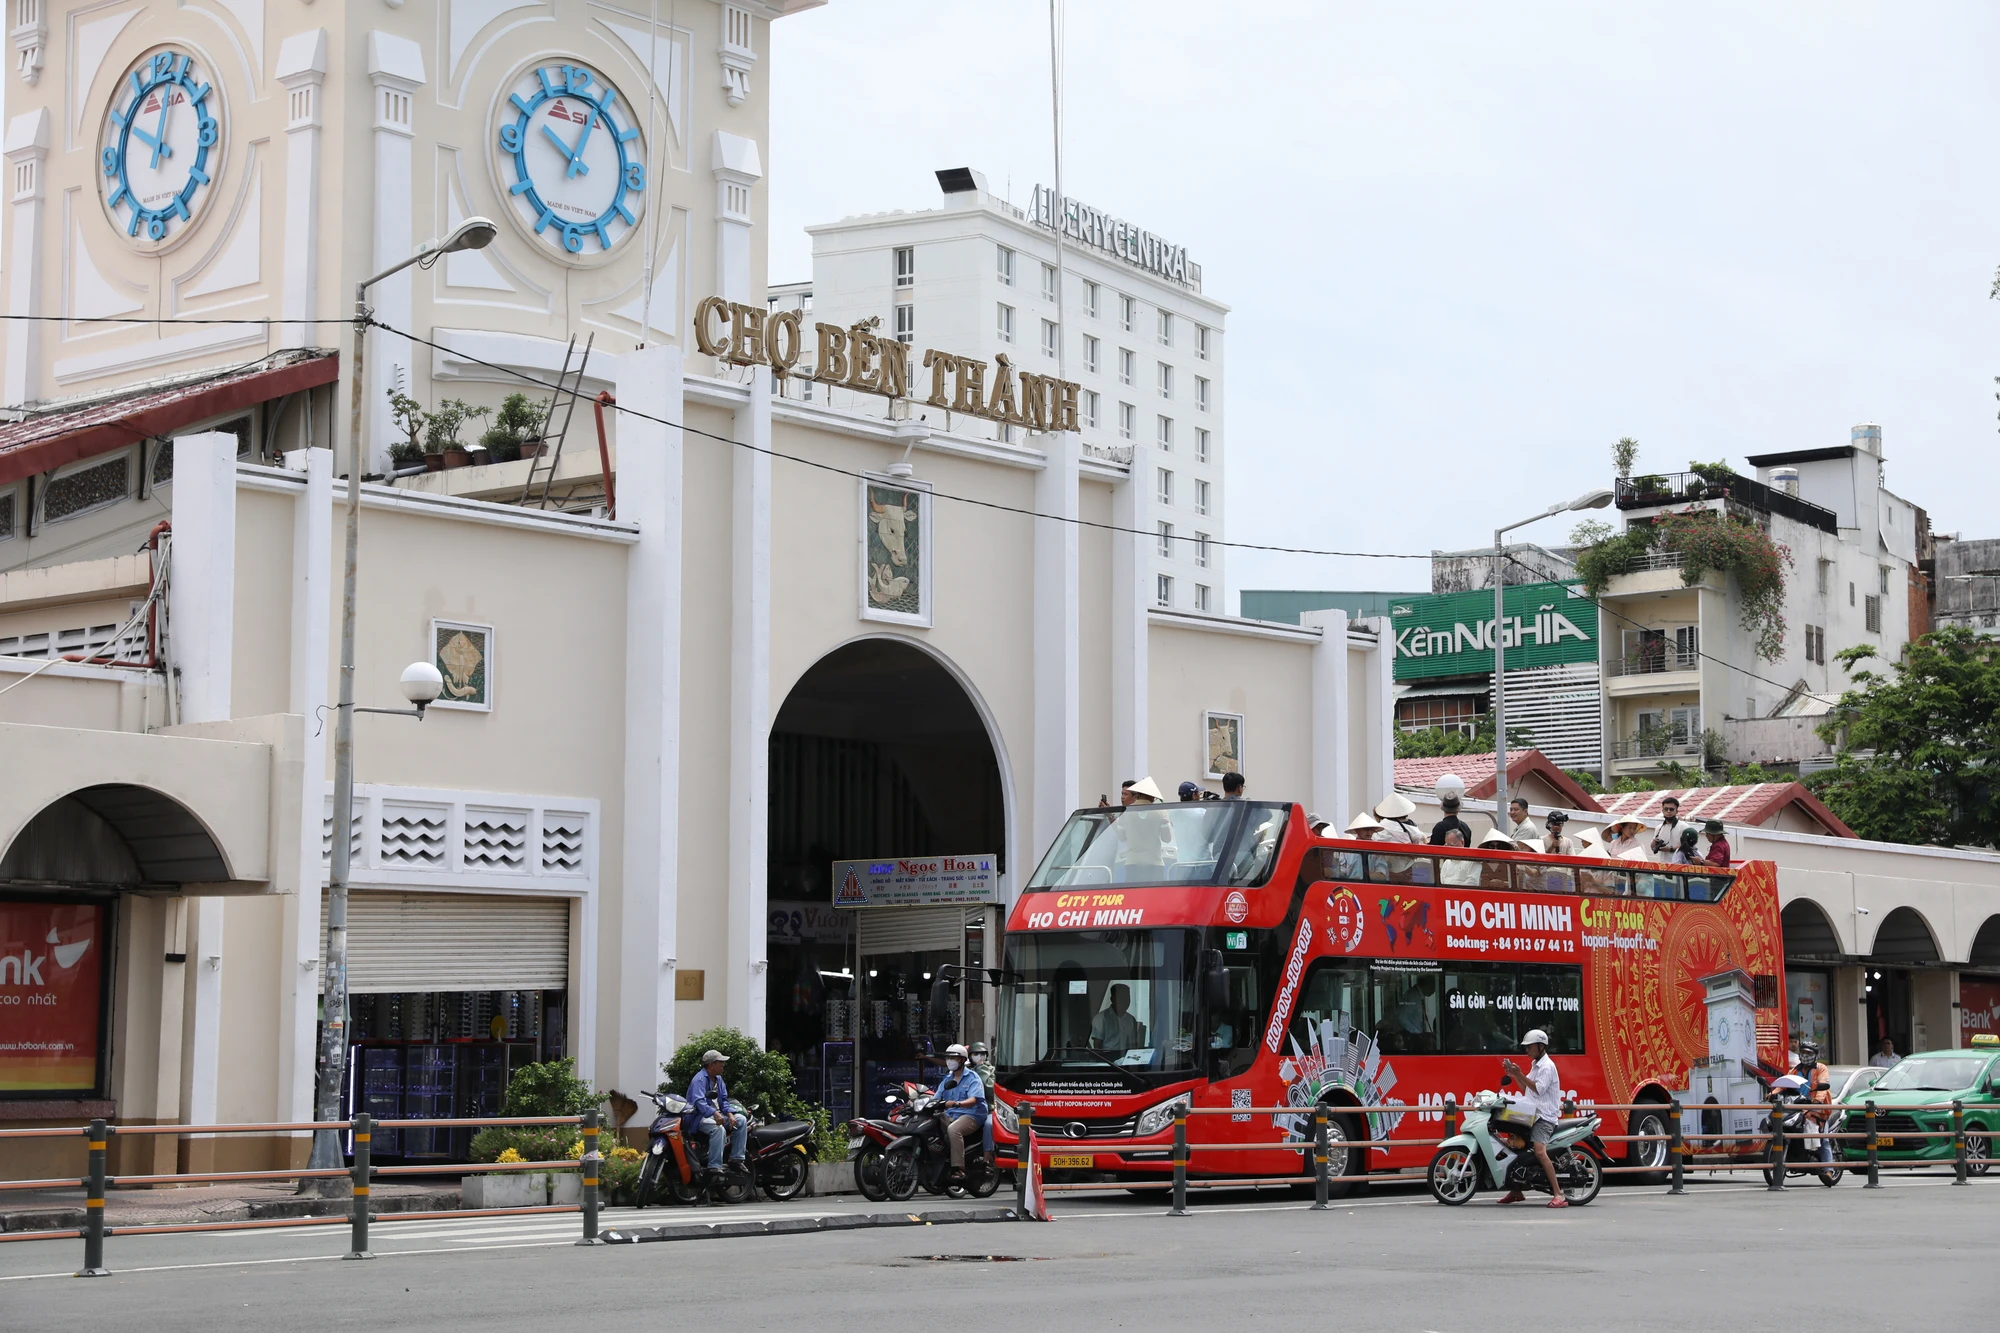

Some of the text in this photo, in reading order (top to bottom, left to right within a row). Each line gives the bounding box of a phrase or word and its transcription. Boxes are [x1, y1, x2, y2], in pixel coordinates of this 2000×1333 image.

[148, 51, 174, 84] 12
[561, 65, 594, 98] 12
[197, 116, 218, 147] 3
[500, 124, 523, 154] 9
[102, 147, 118, 177] 9
[625, 162, 646, 191] 3
[547, 200, 563, 211] MADE
[564, 203, 571, 212] IN
[571, 205, 584, 215] VIET
[148, 210, 165, 241] 6
[563, 222, 584, 253] 6
[694, 296, 1081, 433] CHỢ BẾN THÀNH
[898, 860, 938, 877] Ngọc
[943, 858, 977, 872] Hoa
[1028, 908, 1143, 928] HO CHI MINH
[1445, 899, 1572, 932] HO CHI MINH
[1492, 937, 1511, 950] +84
[1514, 937, 1531, 951] 913
[1533, 938, 1546, 951] 67
[1548, 939, 1560, 952] 44
[1562, 940, 1574, 952] 12
[1581, 931, 1657, 952] hopon-hopoff.vn
[27, 993, 57, 1005] nhất
[1450, 991, 1465, 1009] SÀI
[1467, 991, 1486, 1010] GÒN
[1497, 994, 1514, 1013] CHỢ
[1516, 993, 1533, 1011] LỚN
[1535, 997, 1555, 1011] CITY
[1557, 997, 1579, 1011] TOUR
